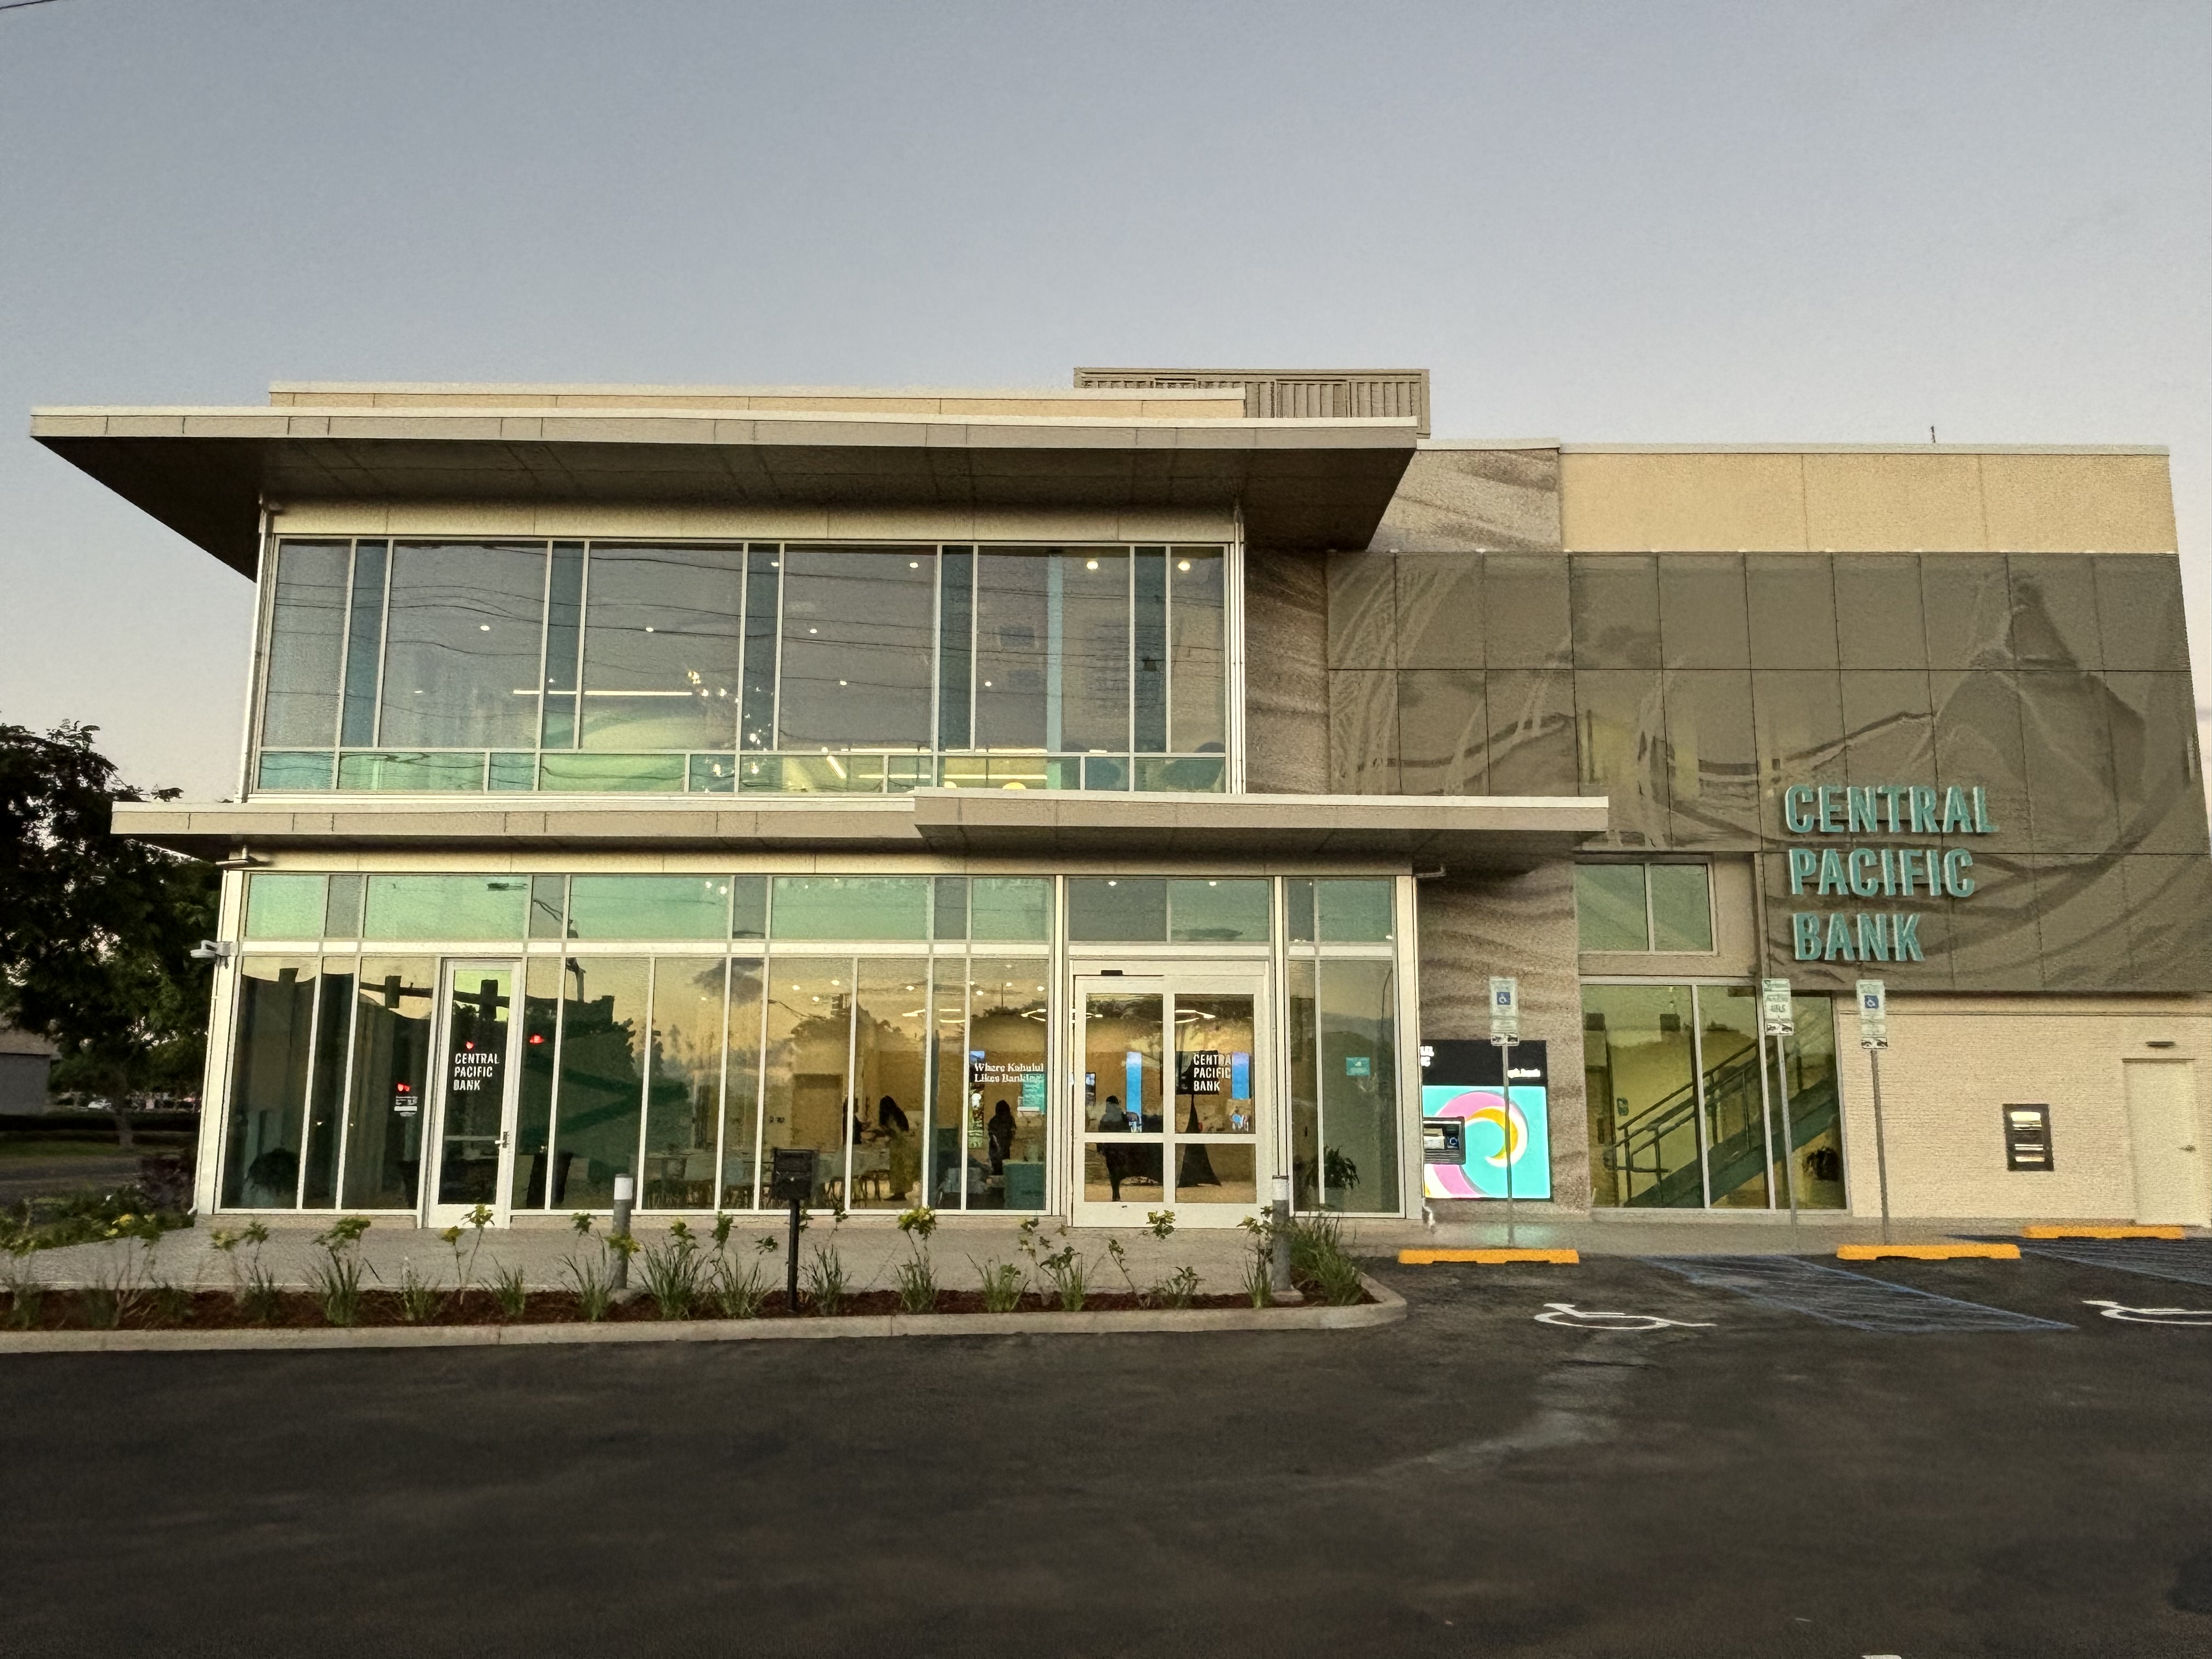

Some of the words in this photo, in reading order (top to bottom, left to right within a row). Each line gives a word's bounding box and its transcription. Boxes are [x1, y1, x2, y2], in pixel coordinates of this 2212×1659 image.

[1785, 785, 1999, 833] CENTRAL
[1789, 848, 1974, 898] PACIFIC
[1792, 912, 1925, 961] BANK
[455, 1053, 500, 1064] CENTRAL
[1193, 1054, 1231, 1065] CENTRA
[454, 1066, 493, 1077] PACIFIC
[974, 1063, 1005, 1072] Where
[1194, 1067, 1231, 1079] PACIFIC
[974, 1074, 1000, 1083] Likes
[453, 1079, 481, 1091] BANK
[1194, 1080, 1220, 1092] BANK
